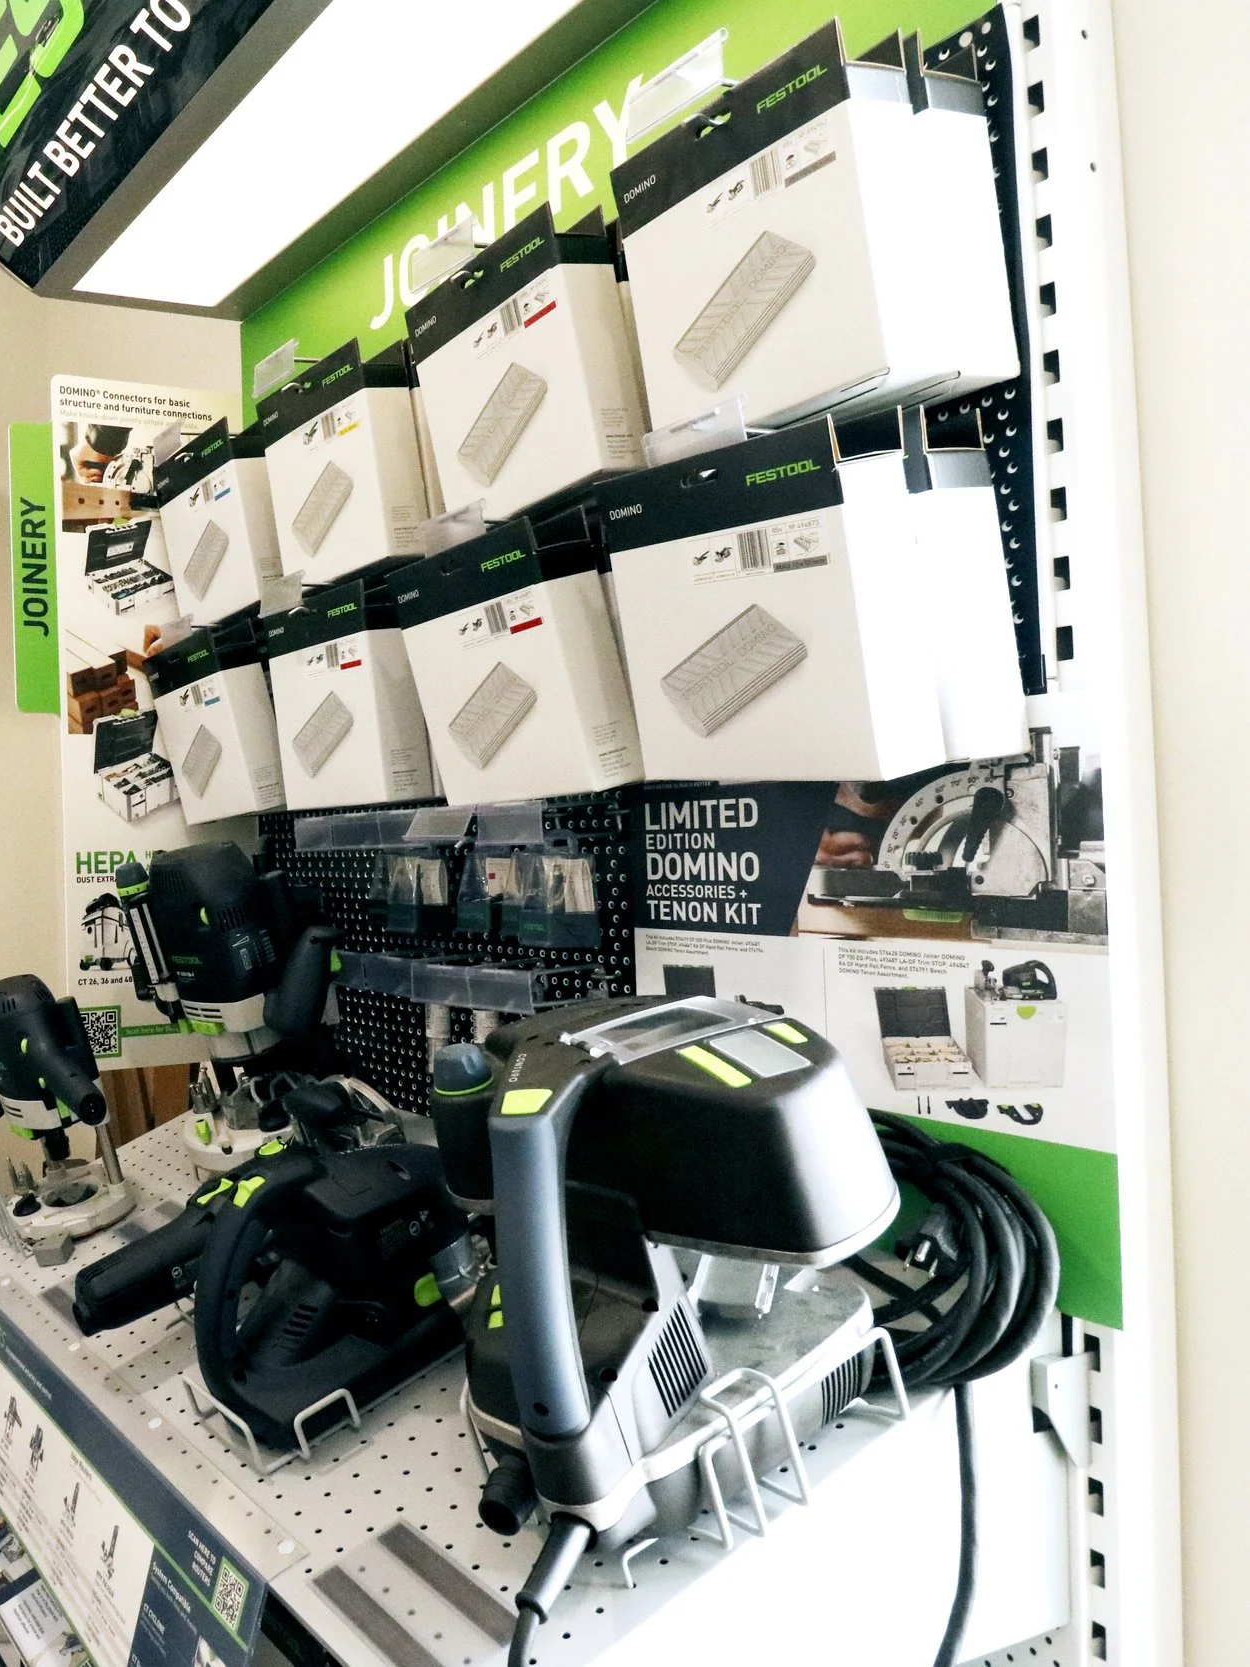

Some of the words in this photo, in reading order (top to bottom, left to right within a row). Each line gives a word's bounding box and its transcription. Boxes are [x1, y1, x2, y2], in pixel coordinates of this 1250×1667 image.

[756, 63, 827, 114] FESTOOL
[43, 44, 154, 177] BETTER
[623, 174, 656, 203] DOMINO
[500, 237, 546, 273] FESTOOL
[414, 315, 437, 338] DOMINO
[322, 363, 354, 388] FESTOOL
[60, 399, 101, 410] structure
[104, 403, 120, 412] and
[122, 404, 160, 416] furniture
[163, 409, 213, 422] connections
[103, 391, 152, 404] Connectors
[154, 396, 167, 405] for
[169, 398, 191, 408] basic
[201, 439, 225, 458] FESTOOL
[745, 459, 821, 487] FESTOOL
[609, 503, 643, 521] DOMINO
[20, 497, 49, 637] JOINERY
[481, 549, 526, 573] FESTOOL
[398, 589, 419, 604] DOMINO
[327, 602, 357, 618] FESTOOL
[268, 626, 284, 638] DOMINO
[187, 649, 209, 664] FESTOOL
[645, 797, 759, 831] LIMITED
[645, 832, 716, 850] EDITION
[646, 851, 760, 882] DOMINO
[646, 884, 736, 899] ACCESSORIES
[739, 889, 748, 898] +
[646, 900, 718, 924] TENON
[725, 902, 761, 925] KIT
[89, 978, 99, 986] 26,
[508, 1052, 527, 1083] CONTURO
[187, 1530, 200, 1546] SCAN
[199, 1542, 210, 1557] HERE
[209, 1555, 217, 1565] TO
[191, 1561, 211, 1588] ROUTERS
[193, 1550, 215, 1576] COMPARE
[152, 1562, 168, 1584] System
[167, 1579, 191, 1613] Compatible
[143, 1603, 150, 1612] CT
[149, 1608, 166, 1635] CYCLONE
